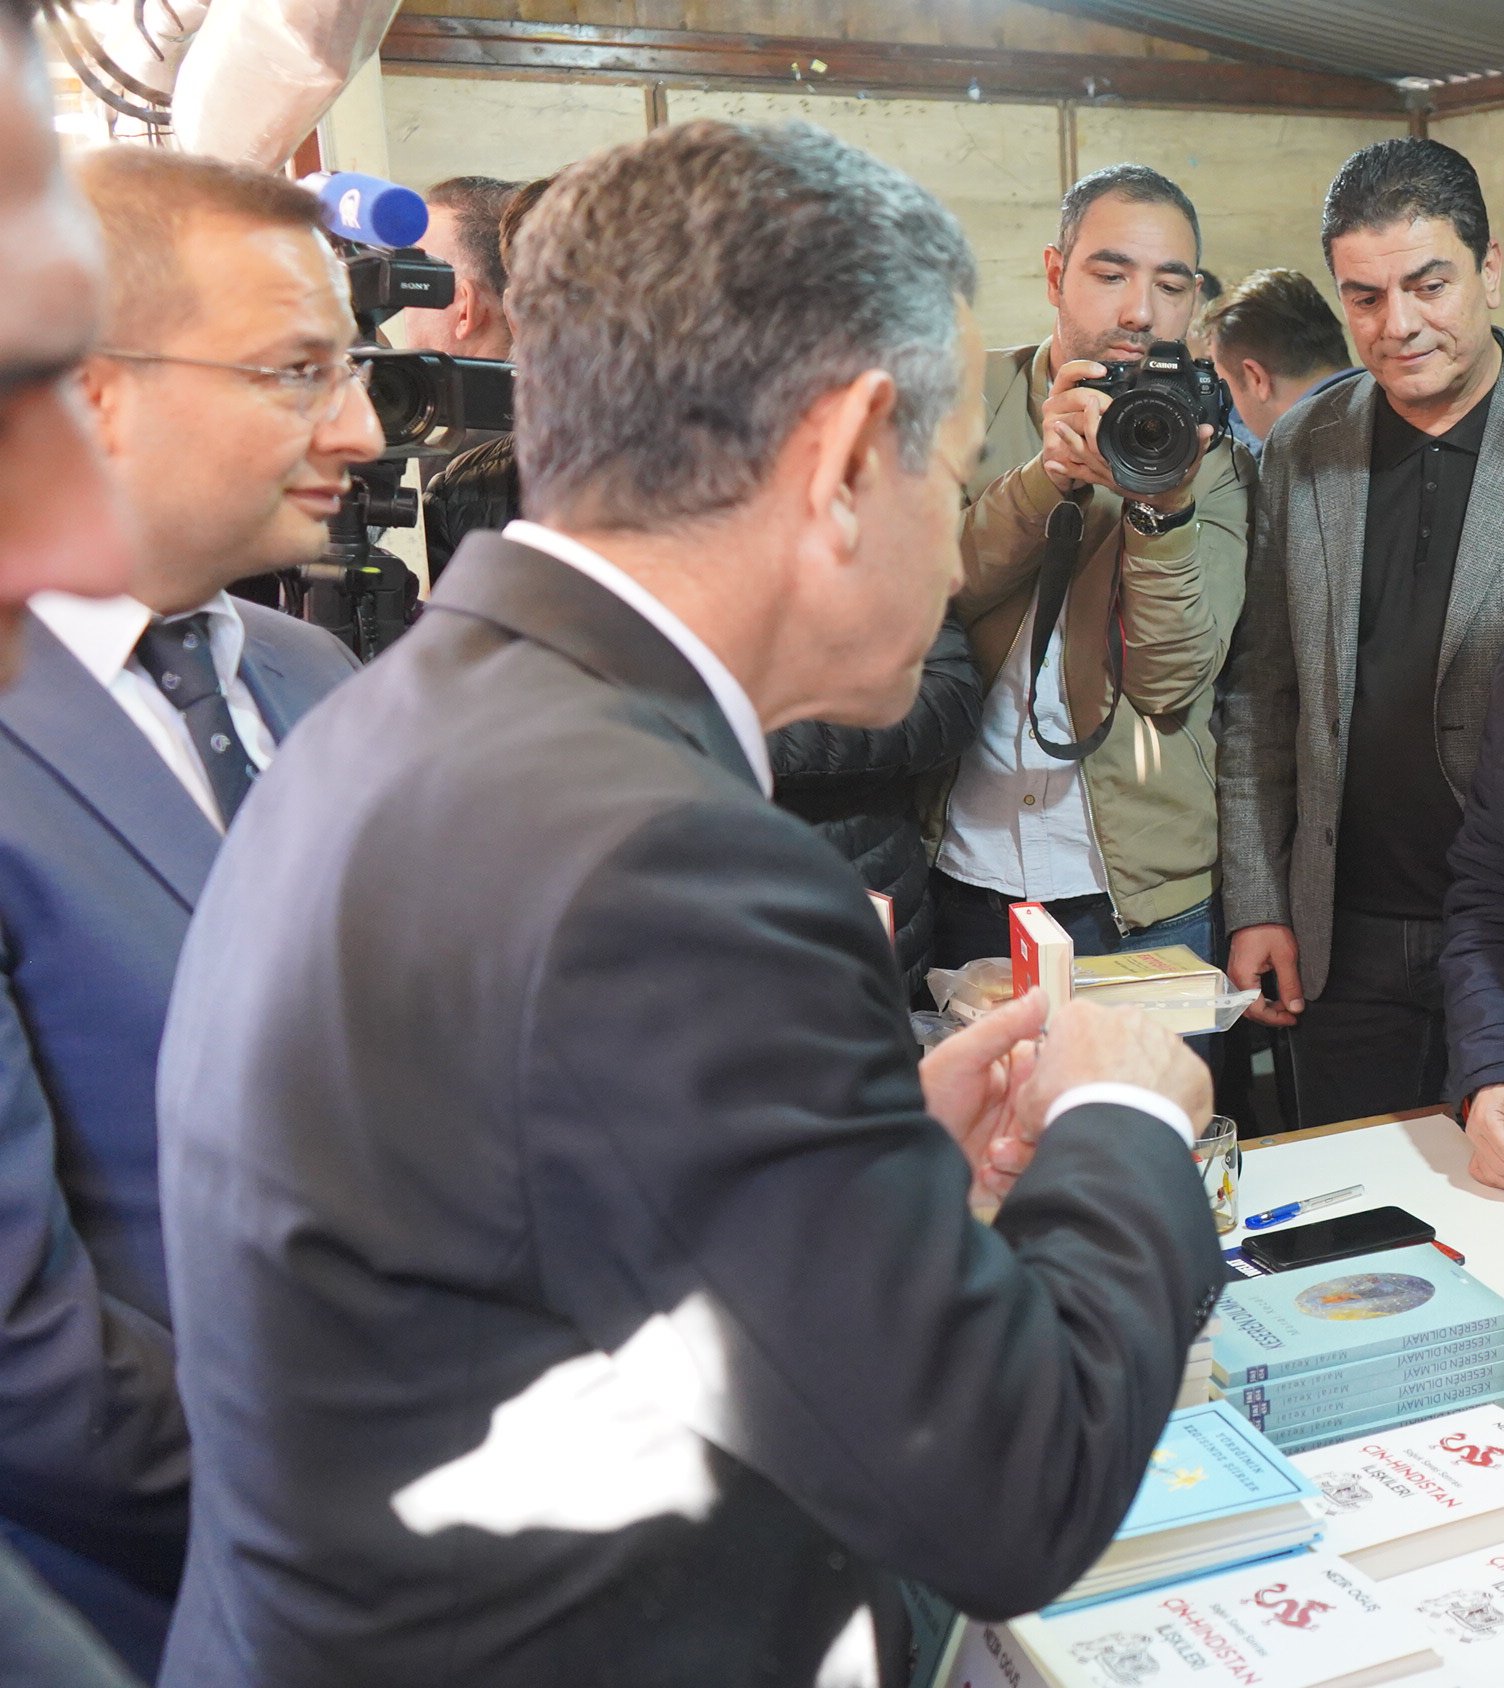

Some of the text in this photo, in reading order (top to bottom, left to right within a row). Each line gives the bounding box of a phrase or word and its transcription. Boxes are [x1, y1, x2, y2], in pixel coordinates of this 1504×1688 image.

[400, 282, 430, 291] SONY
[1149, 361, 1178, 370] Canon
[1312, 1350, 1348, 1366] Maral
[1308, 1369, 1344, 1386] Maral
[1314, 1383, 1349, 1400] Maral
[1309, 1400, 1344, 1417] Maral
[1309, 1416, 1342, 1432] Maral
